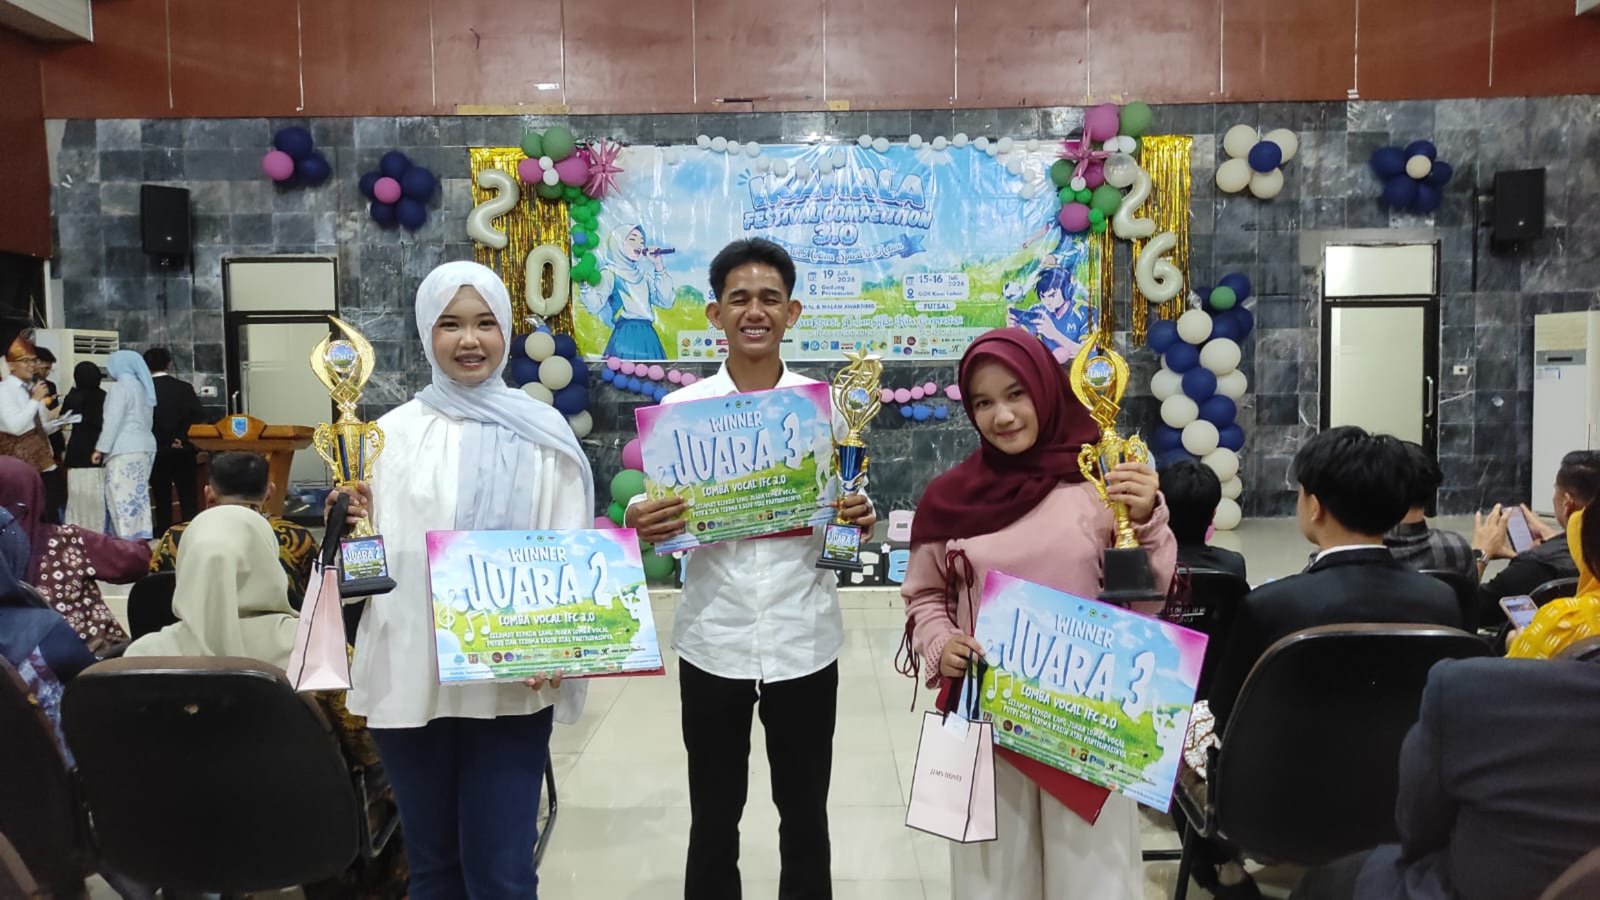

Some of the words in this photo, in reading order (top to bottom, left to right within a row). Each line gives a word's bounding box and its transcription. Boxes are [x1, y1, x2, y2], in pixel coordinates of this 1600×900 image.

[749, 164, 926, 211] IKAMALA
[743, 205, 819, 230] FESTIVAL
[822, 204, 933, 230] COMPETITION
[823, 269, 834, 280] 19
[919, 274, 943, 284] 15-16
[709, 410, 763, 433] WINNER
[673, 427, 777, 485] JUARA
[781, 411, 802, 470] 3
[702, 485, 730, 497] LOMBA
[733, 481, 757, 492] VOCAL
[759, 477, 772, 487] IFC
[772, 474, 787, 485] 3.0
[695, 501, 717, 510] SELAMAT
[765, 491, 781, 500] LOMBA
[720, 505, 738, 514] TERIMA
[346, 548, 374, 561] JUARA
[509, 545, 567, 563] WINNER
[464, 553, 582, 612] JUARA
[588, 551, 614, 608] 2
[499, 615, 531, 626] LOMBA
[534, 613, 561, 625] VOCAL
[564, 612, 579, 623] IFC
[580, 611, 596, 622] 3.0
[516, 630, 537, 639] KEPADA
[572, 627, 591, 635] LOMBA
[518, 637, 540, 645] TERIMA
[1055, 613, 1115, 650] WINNER
[1000, 608, 1116, 704] JUARA
[1121, 651, 1156, 721] 3
[1021, 684, 1051, 705] LOMBA
[1053, 697, 1084, 716] VOCAL
[1084, 706, 1101, 722] IFC
[1101, 713, 1118, 730] 3.0
[1031, 714, 1052, 730] TERIMA
[1086, 727, 1107, 741] LOMBA
[1107, 734, 1125, 748] VOCAL
